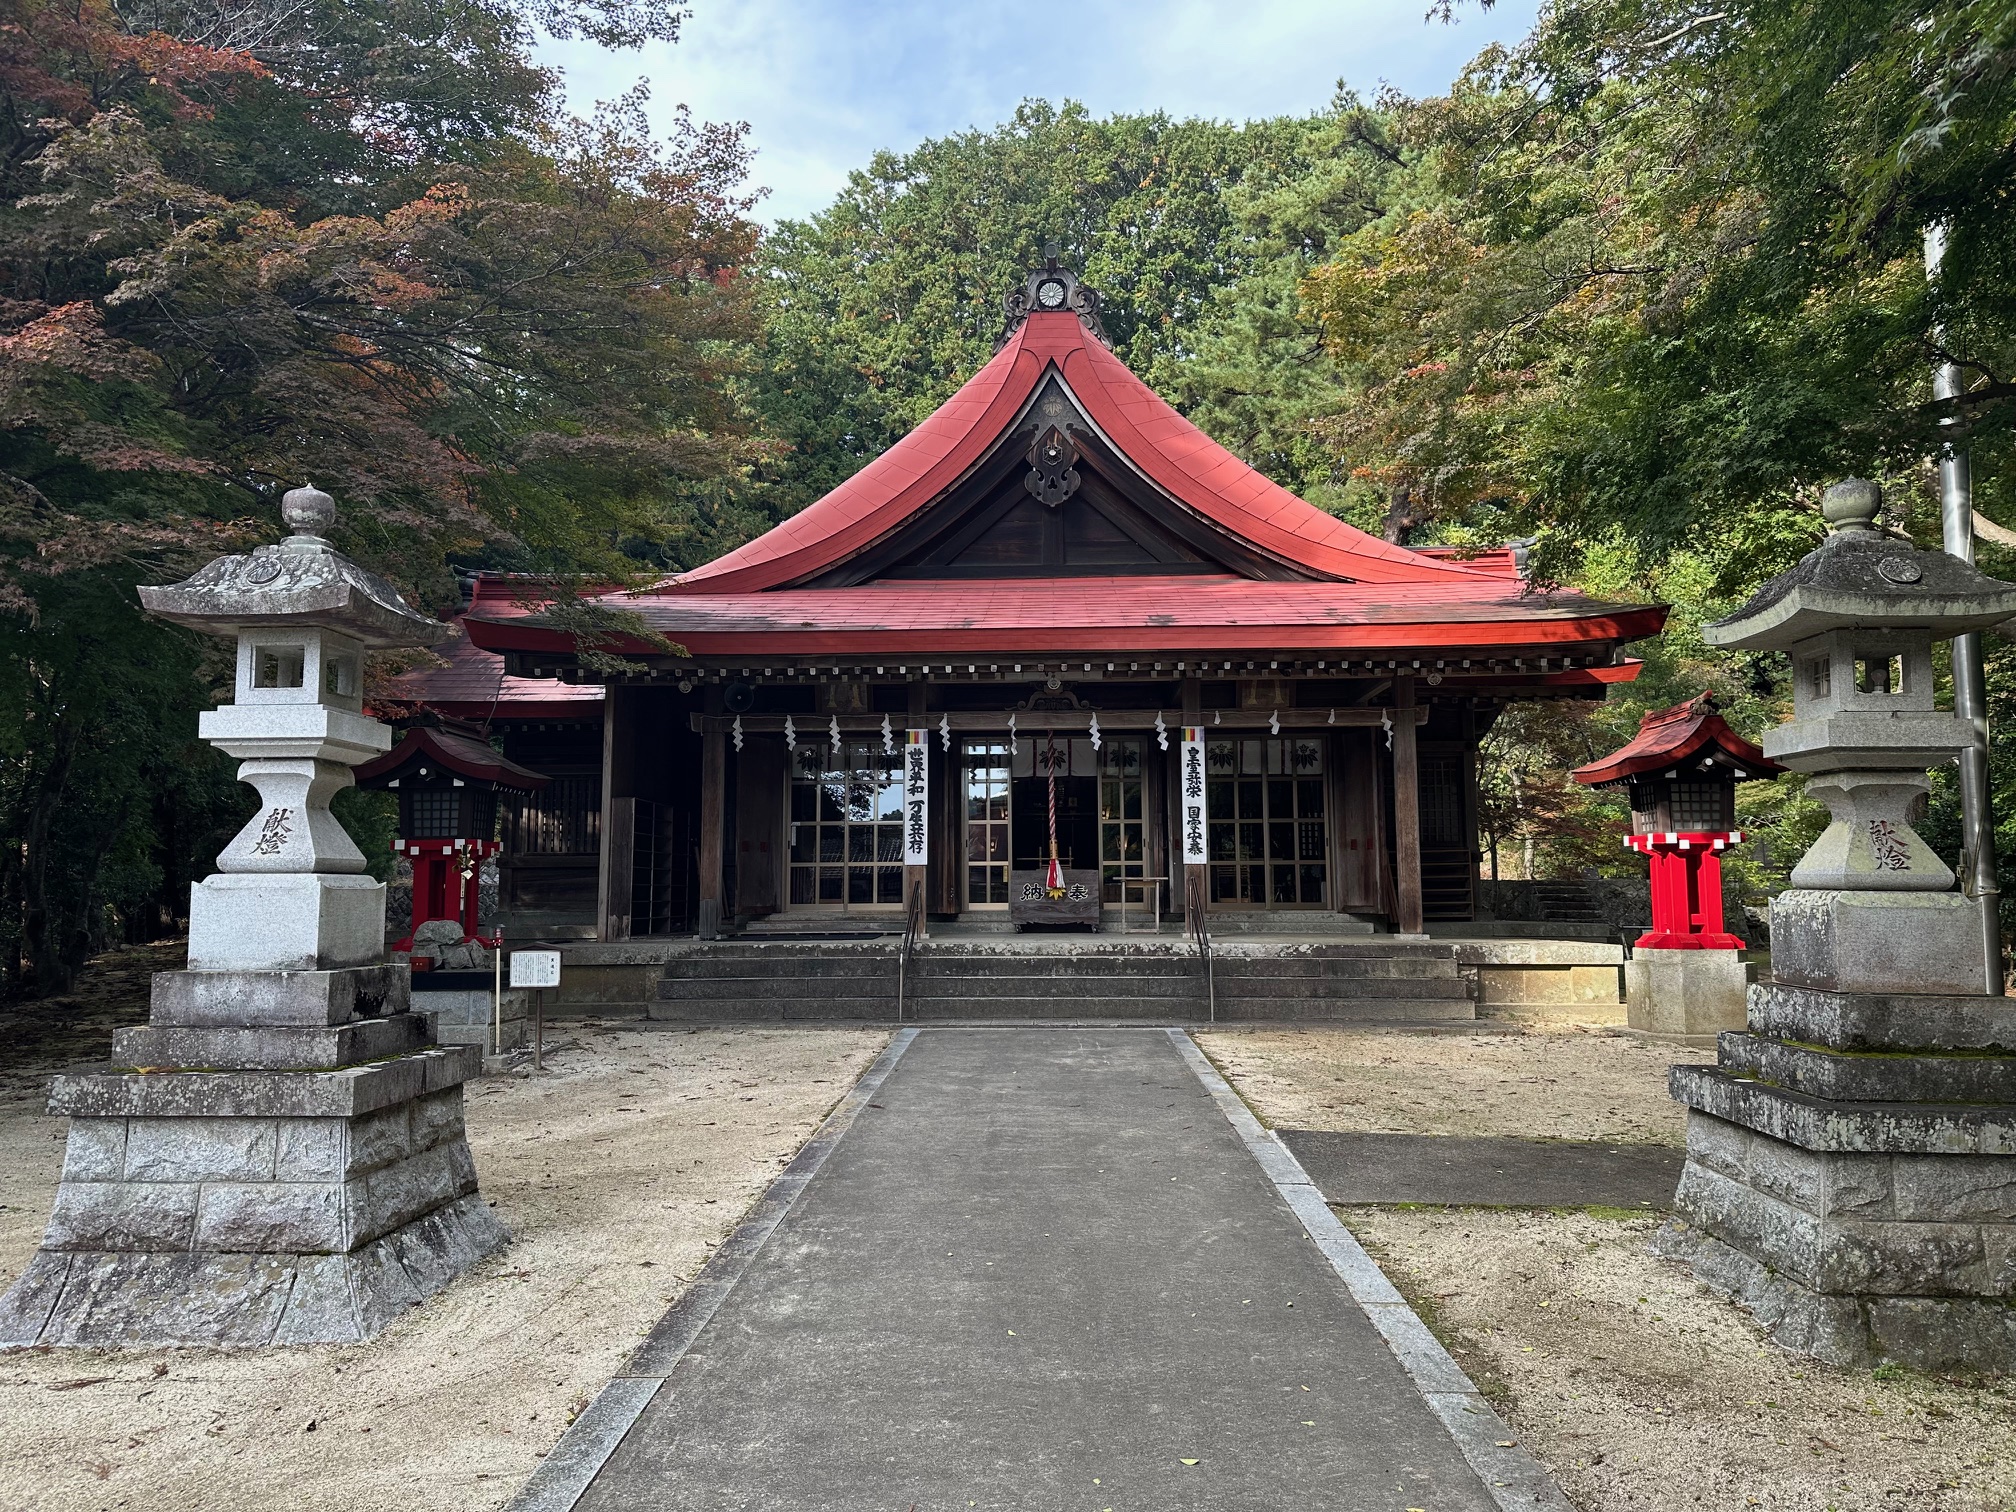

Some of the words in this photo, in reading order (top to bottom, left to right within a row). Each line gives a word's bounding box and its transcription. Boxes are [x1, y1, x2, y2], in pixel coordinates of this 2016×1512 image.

[907, 747, 925, 796] 世界平和
[1186, 746, 1202, 798] 皇室弥栄
[907, 799, 925, 854] 万生共存
[1187, 805, 1203, 855] 国家安泰
[1020, 882, 1045, 902] 納
[1068, 882, 1088, 902] 奉
